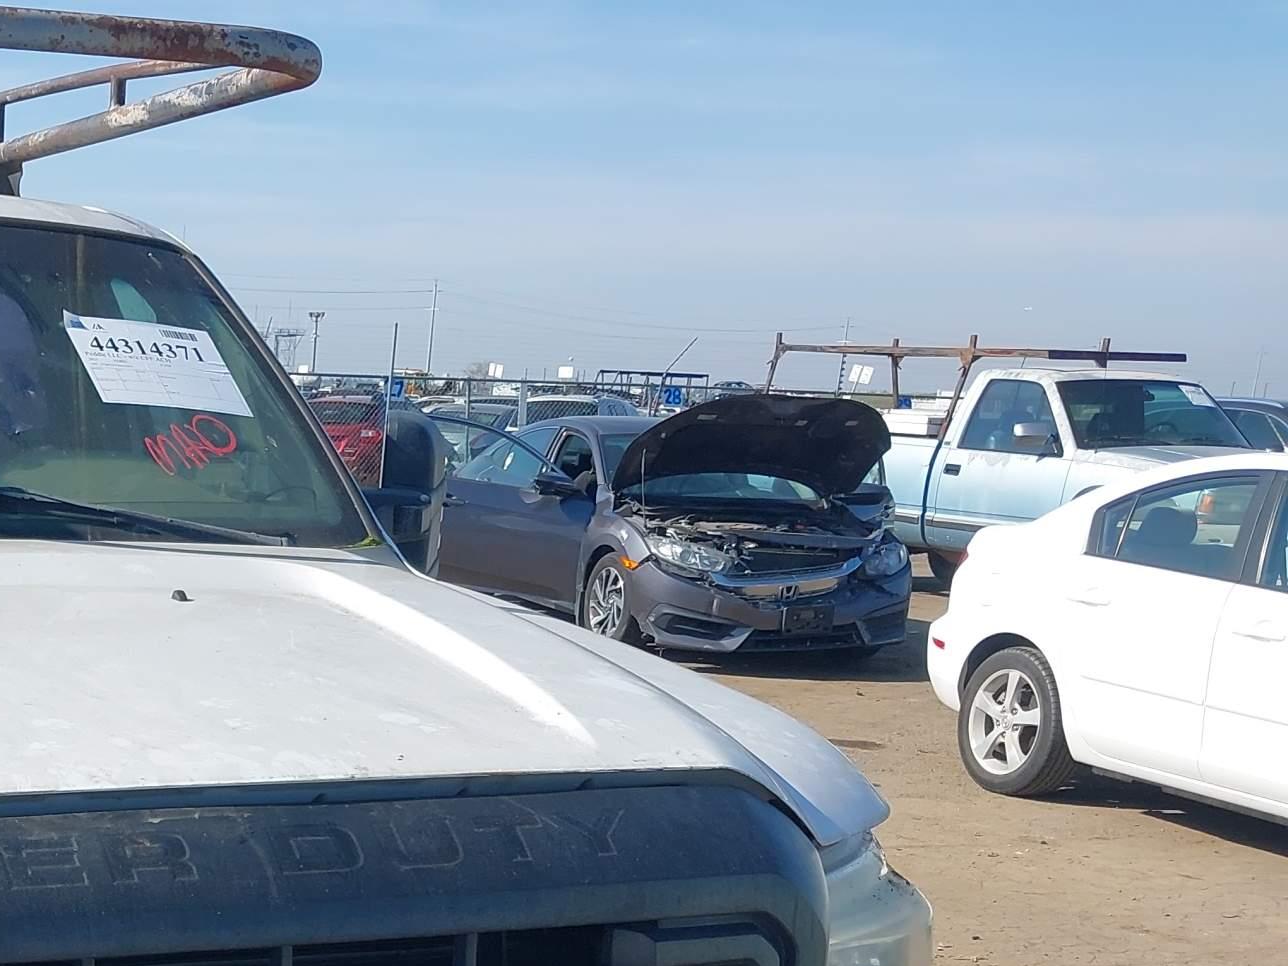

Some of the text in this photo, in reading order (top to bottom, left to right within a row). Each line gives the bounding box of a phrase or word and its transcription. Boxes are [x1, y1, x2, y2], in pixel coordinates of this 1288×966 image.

[90, 335, 205, 362] 44314371
[663, 387, 682, 404] 28
[268, 807, 626, 876] DUTY
